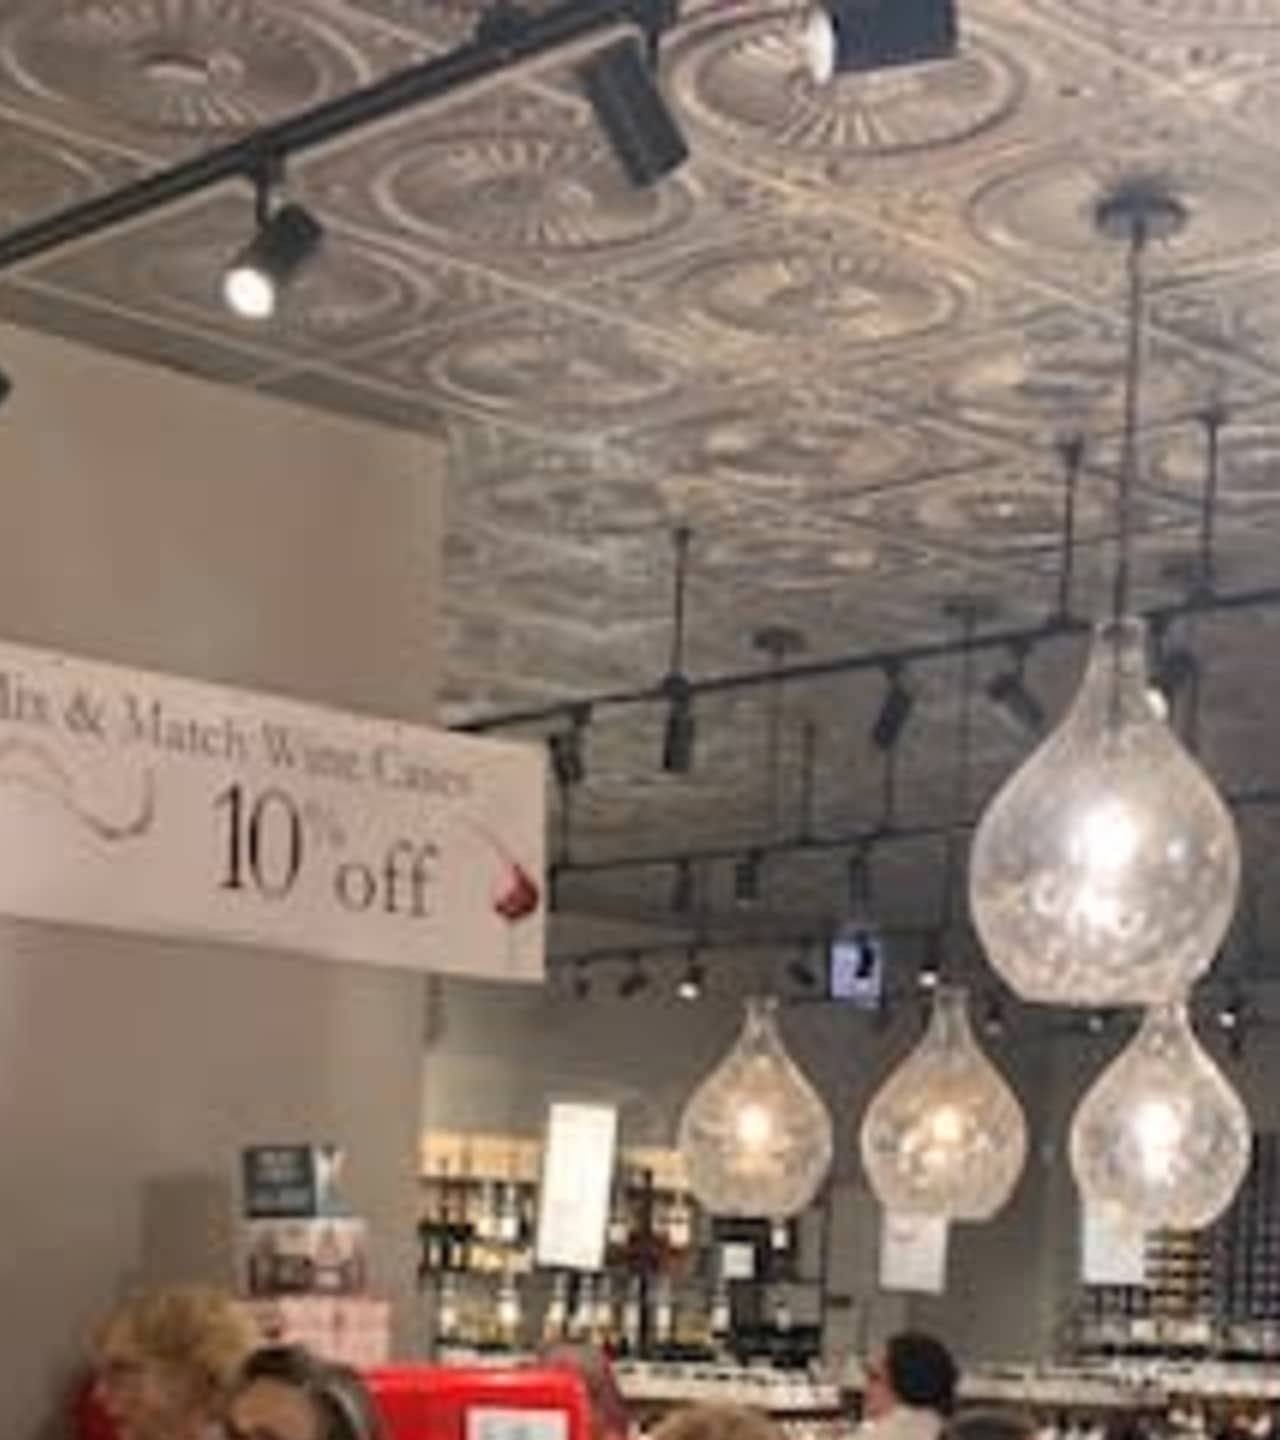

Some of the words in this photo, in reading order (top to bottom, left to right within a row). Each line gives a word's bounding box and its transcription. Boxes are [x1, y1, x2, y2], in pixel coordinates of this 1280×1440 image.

[65, 691, 108, 736] &
[123, 696, 252, 765] Match
[259, 722, 360, 777] Wine
[370, 746, 474, 798] Cases
[334, 837, 441, 918] off
